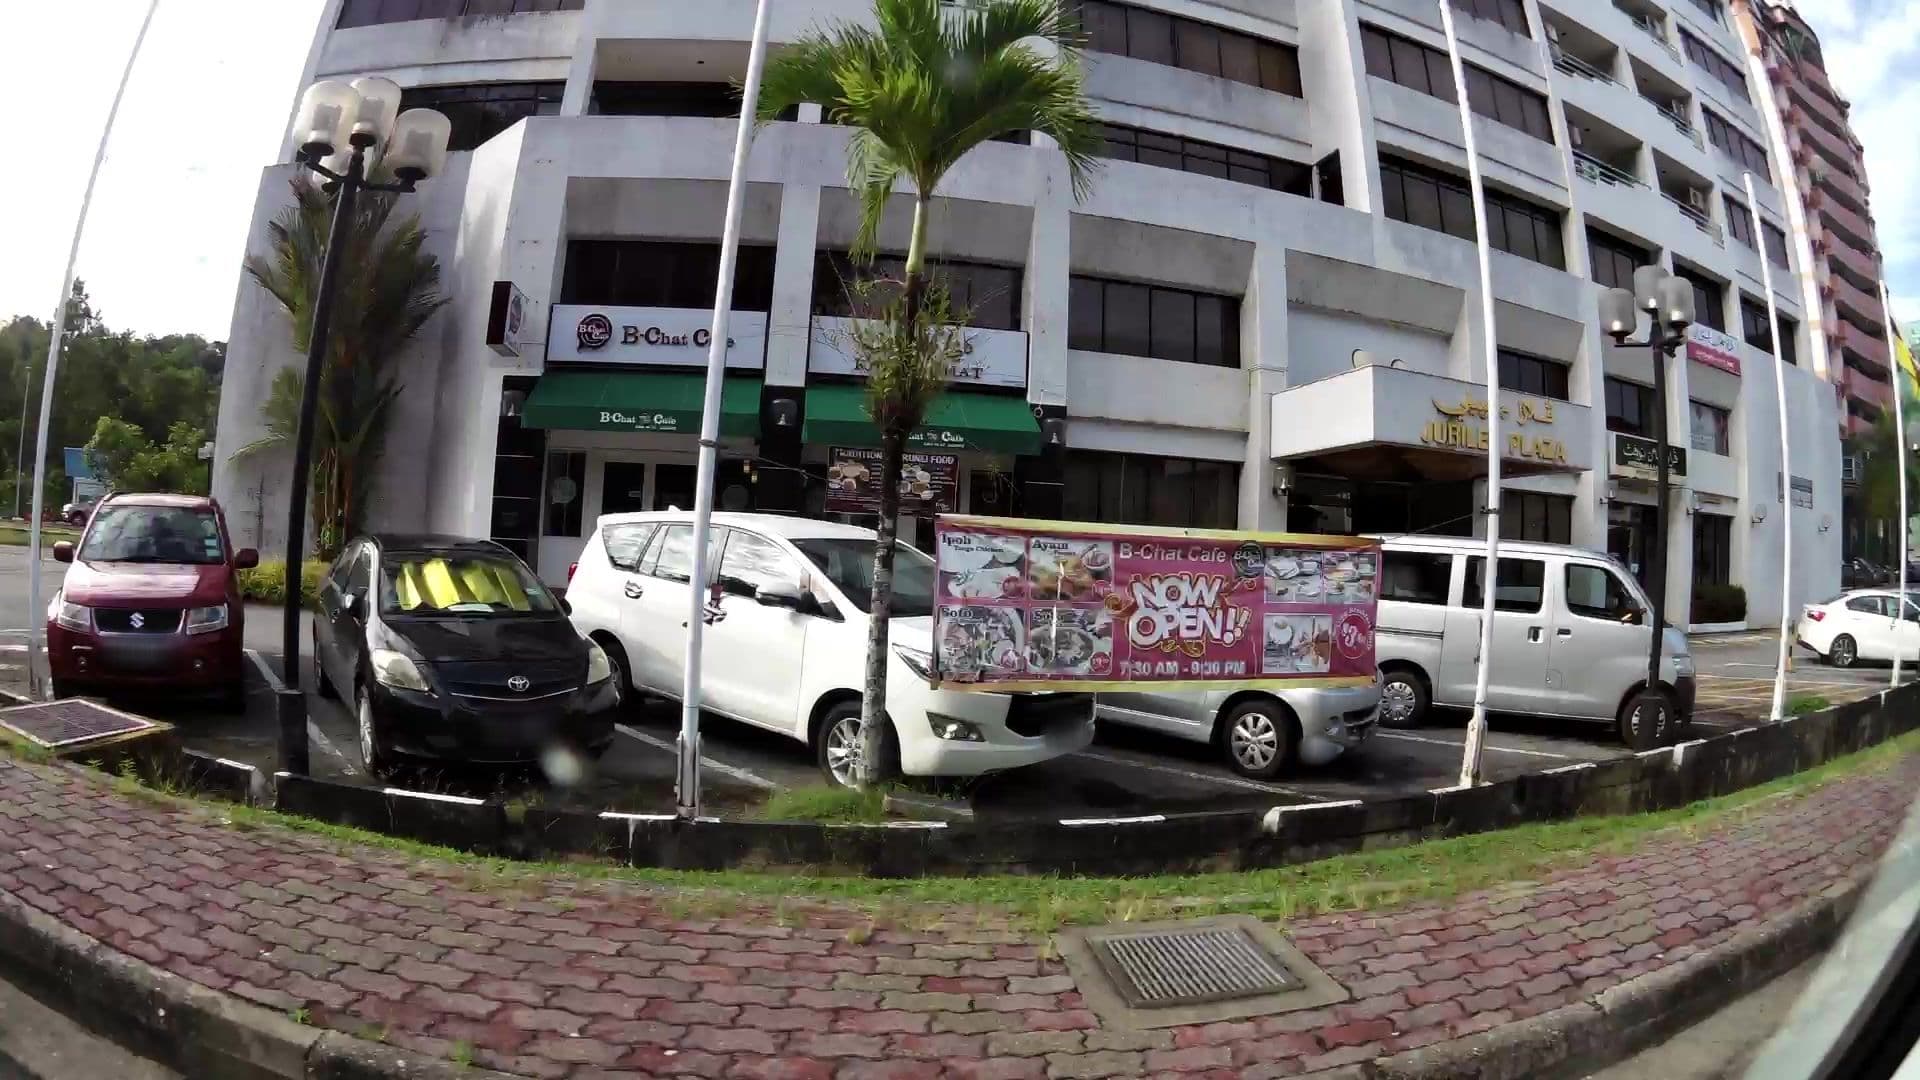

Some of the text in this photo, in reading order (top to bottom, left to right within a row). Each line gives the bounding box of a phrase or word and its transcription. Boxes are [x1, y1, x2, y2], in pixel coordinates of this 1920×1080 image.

[621, 325, 735, 348] B-Chat Ce
[1420, 419, 1568, 464] JUBILE PLAZA
[941, 533, 972, 545] Ipoh
[1031, 539, 1069, 551] Ayam
[1119, 542, 1183, 561] B-Chat
[1187, 546, 1226, 563] Cafe
[1131, 575, 1223, 609] NOW
[1129, 606, 1250, 646] OPEN!!
[1155, 661, 1180, 676] AM
